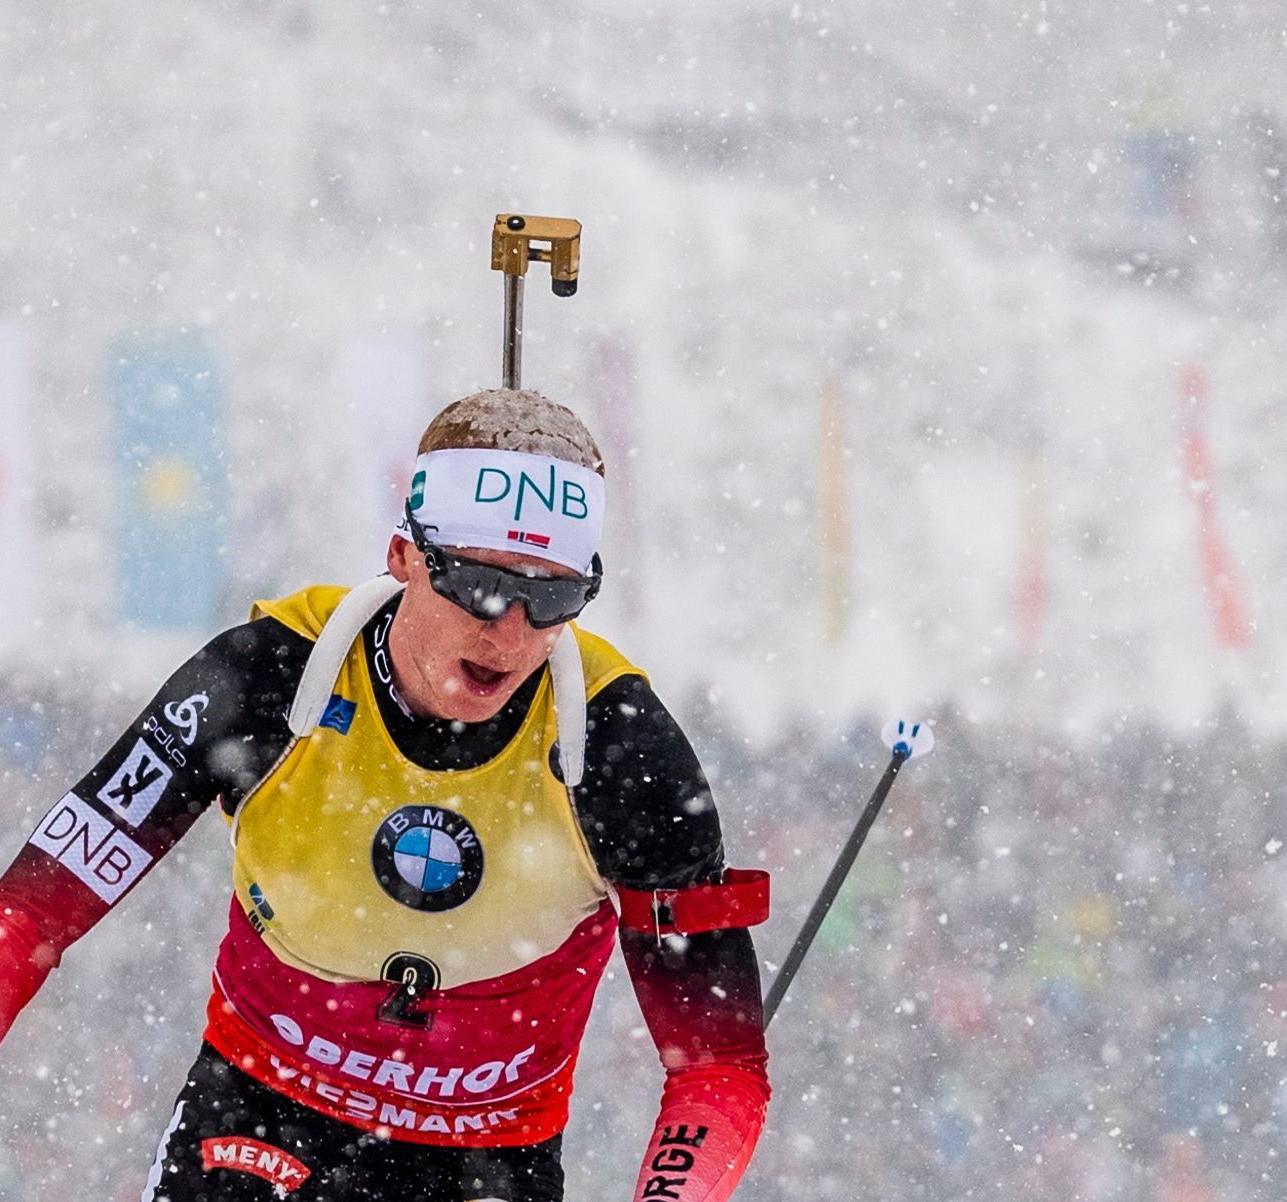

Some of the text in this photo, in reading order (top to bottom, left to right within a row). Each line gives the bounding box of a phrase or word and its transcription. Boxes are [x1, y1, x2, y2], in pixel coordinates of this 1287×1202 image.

[475, 464, 589, 521] DNB
[43, 806, 132, 885] DNB
[387, 808, 477, 849] BMW
[375, 951, 442, 1032] 2
[270, 1013, 536, 1097] OBERHOF
[212, 1143, 298, 1181] MENY
